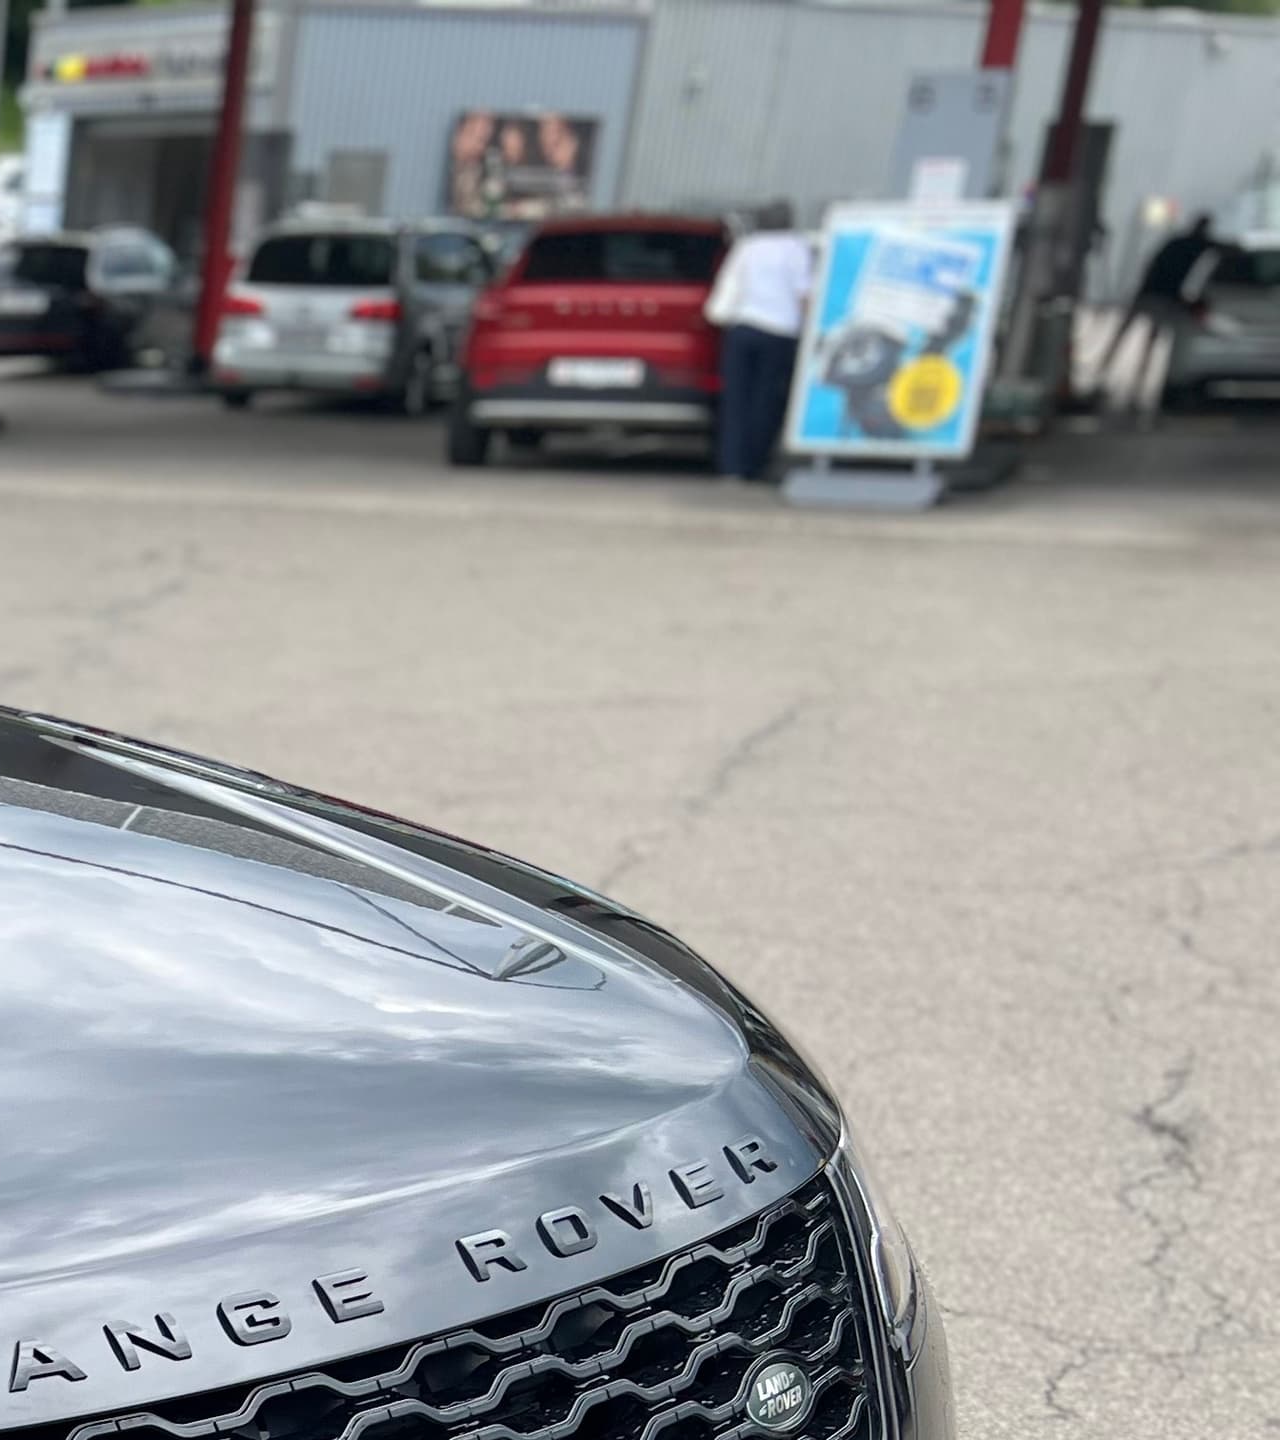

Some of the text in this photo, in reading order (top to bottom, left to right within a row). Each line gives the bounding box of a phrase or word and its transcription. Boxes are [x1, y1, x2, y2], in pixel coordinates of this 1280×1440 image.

[455, 1134, 779, 1283] ROVER
[756, 1371, 790, 1401] LAND
[767, 1385, 803, 1419] ROVER
